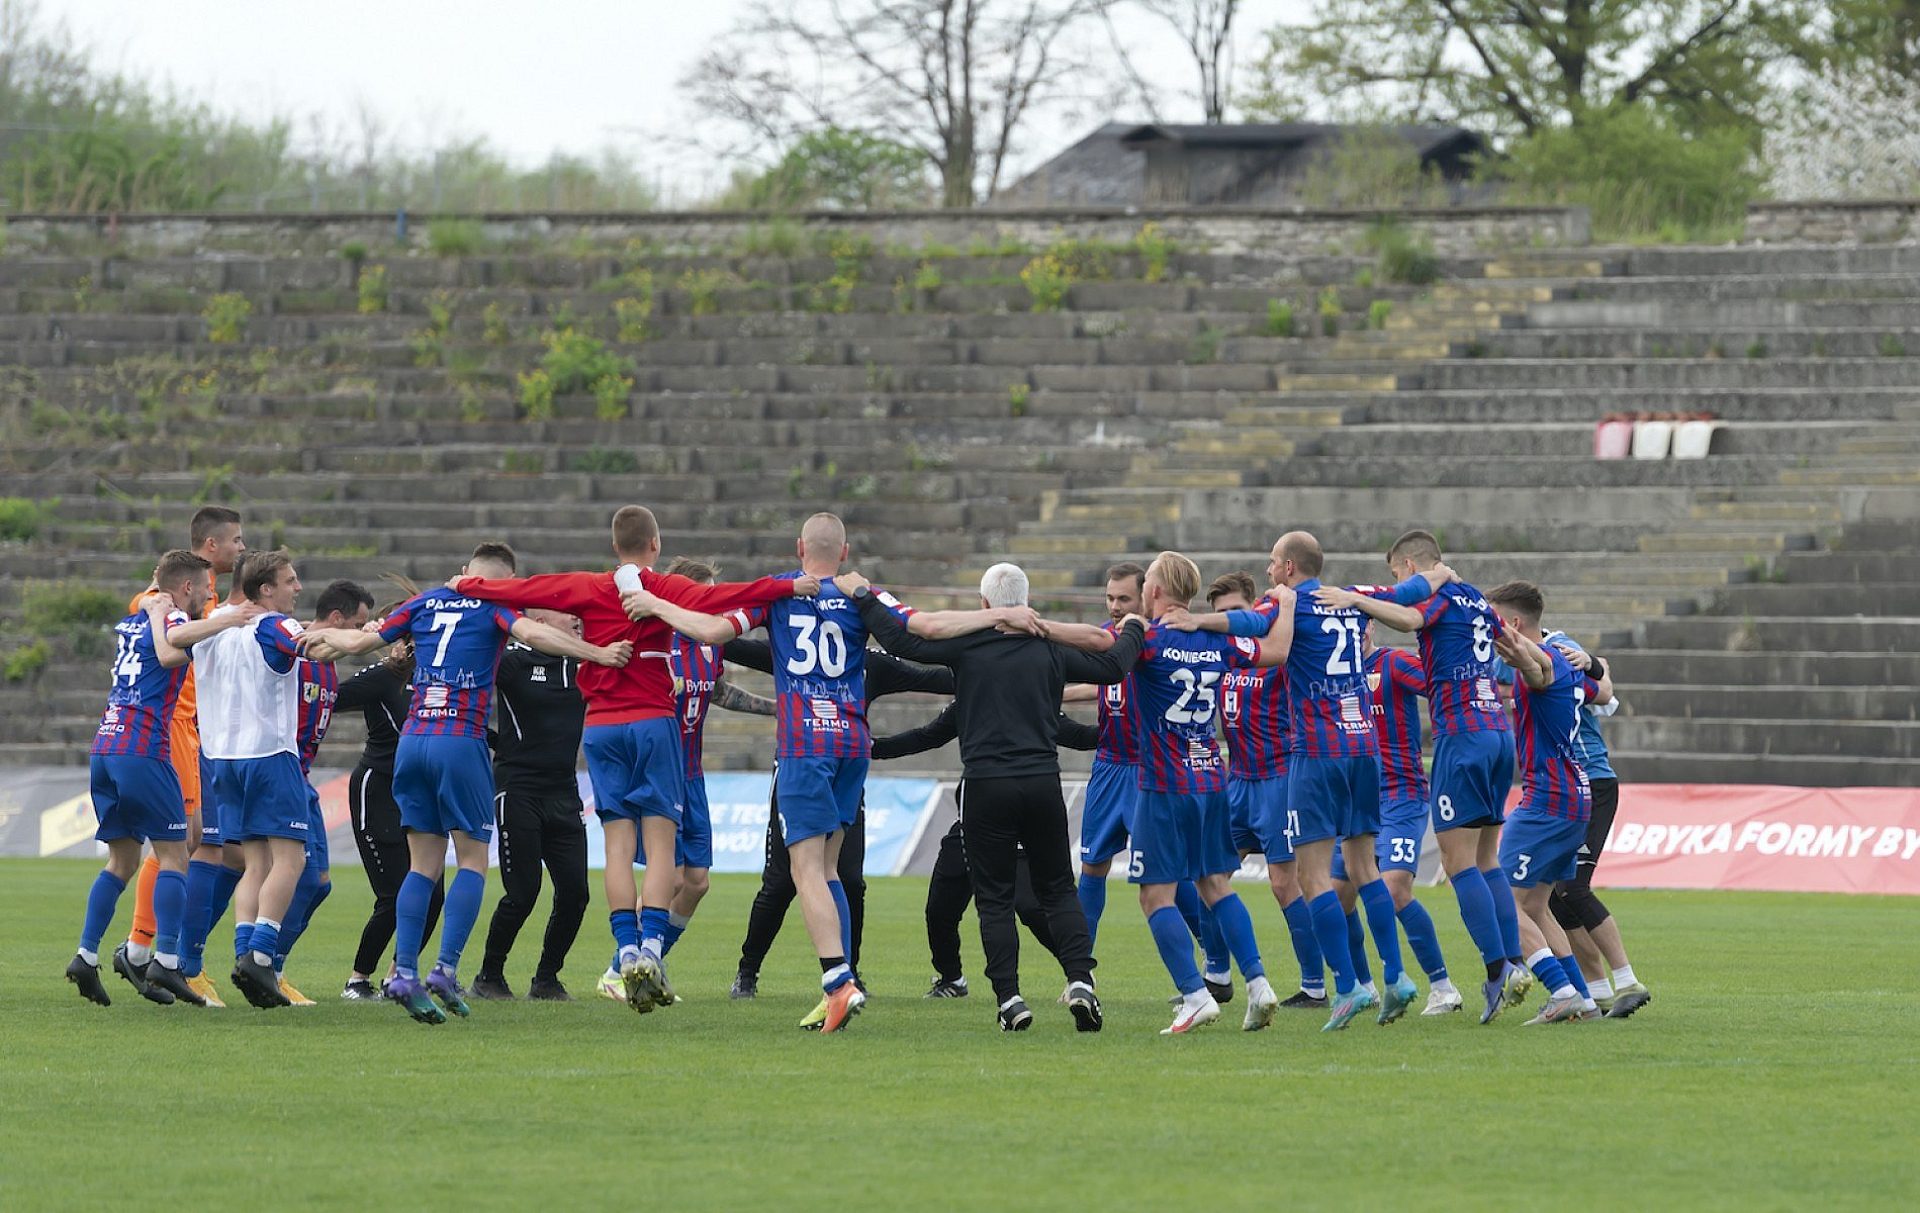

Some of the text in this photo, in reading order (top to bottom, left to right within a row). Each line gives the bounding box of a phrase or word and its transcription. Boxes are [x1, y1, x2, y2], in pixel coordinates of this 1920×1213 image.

[430, 612, 463, 667] 7
[786, 614, 847, 678] 30
[1321, 617, 1362, 675] 21
[1164, 668, 1220, 724] 25
[1223, 672, 1264, 690] Bytom
[803, 718, 850, 729] TERMO
[1438, 795, 1455, 821] 8
[1390, 838, 1415, 863] 33
[1734, 821, 1876, 857] FORMY
[1513, 853, 1531, 880] 3
